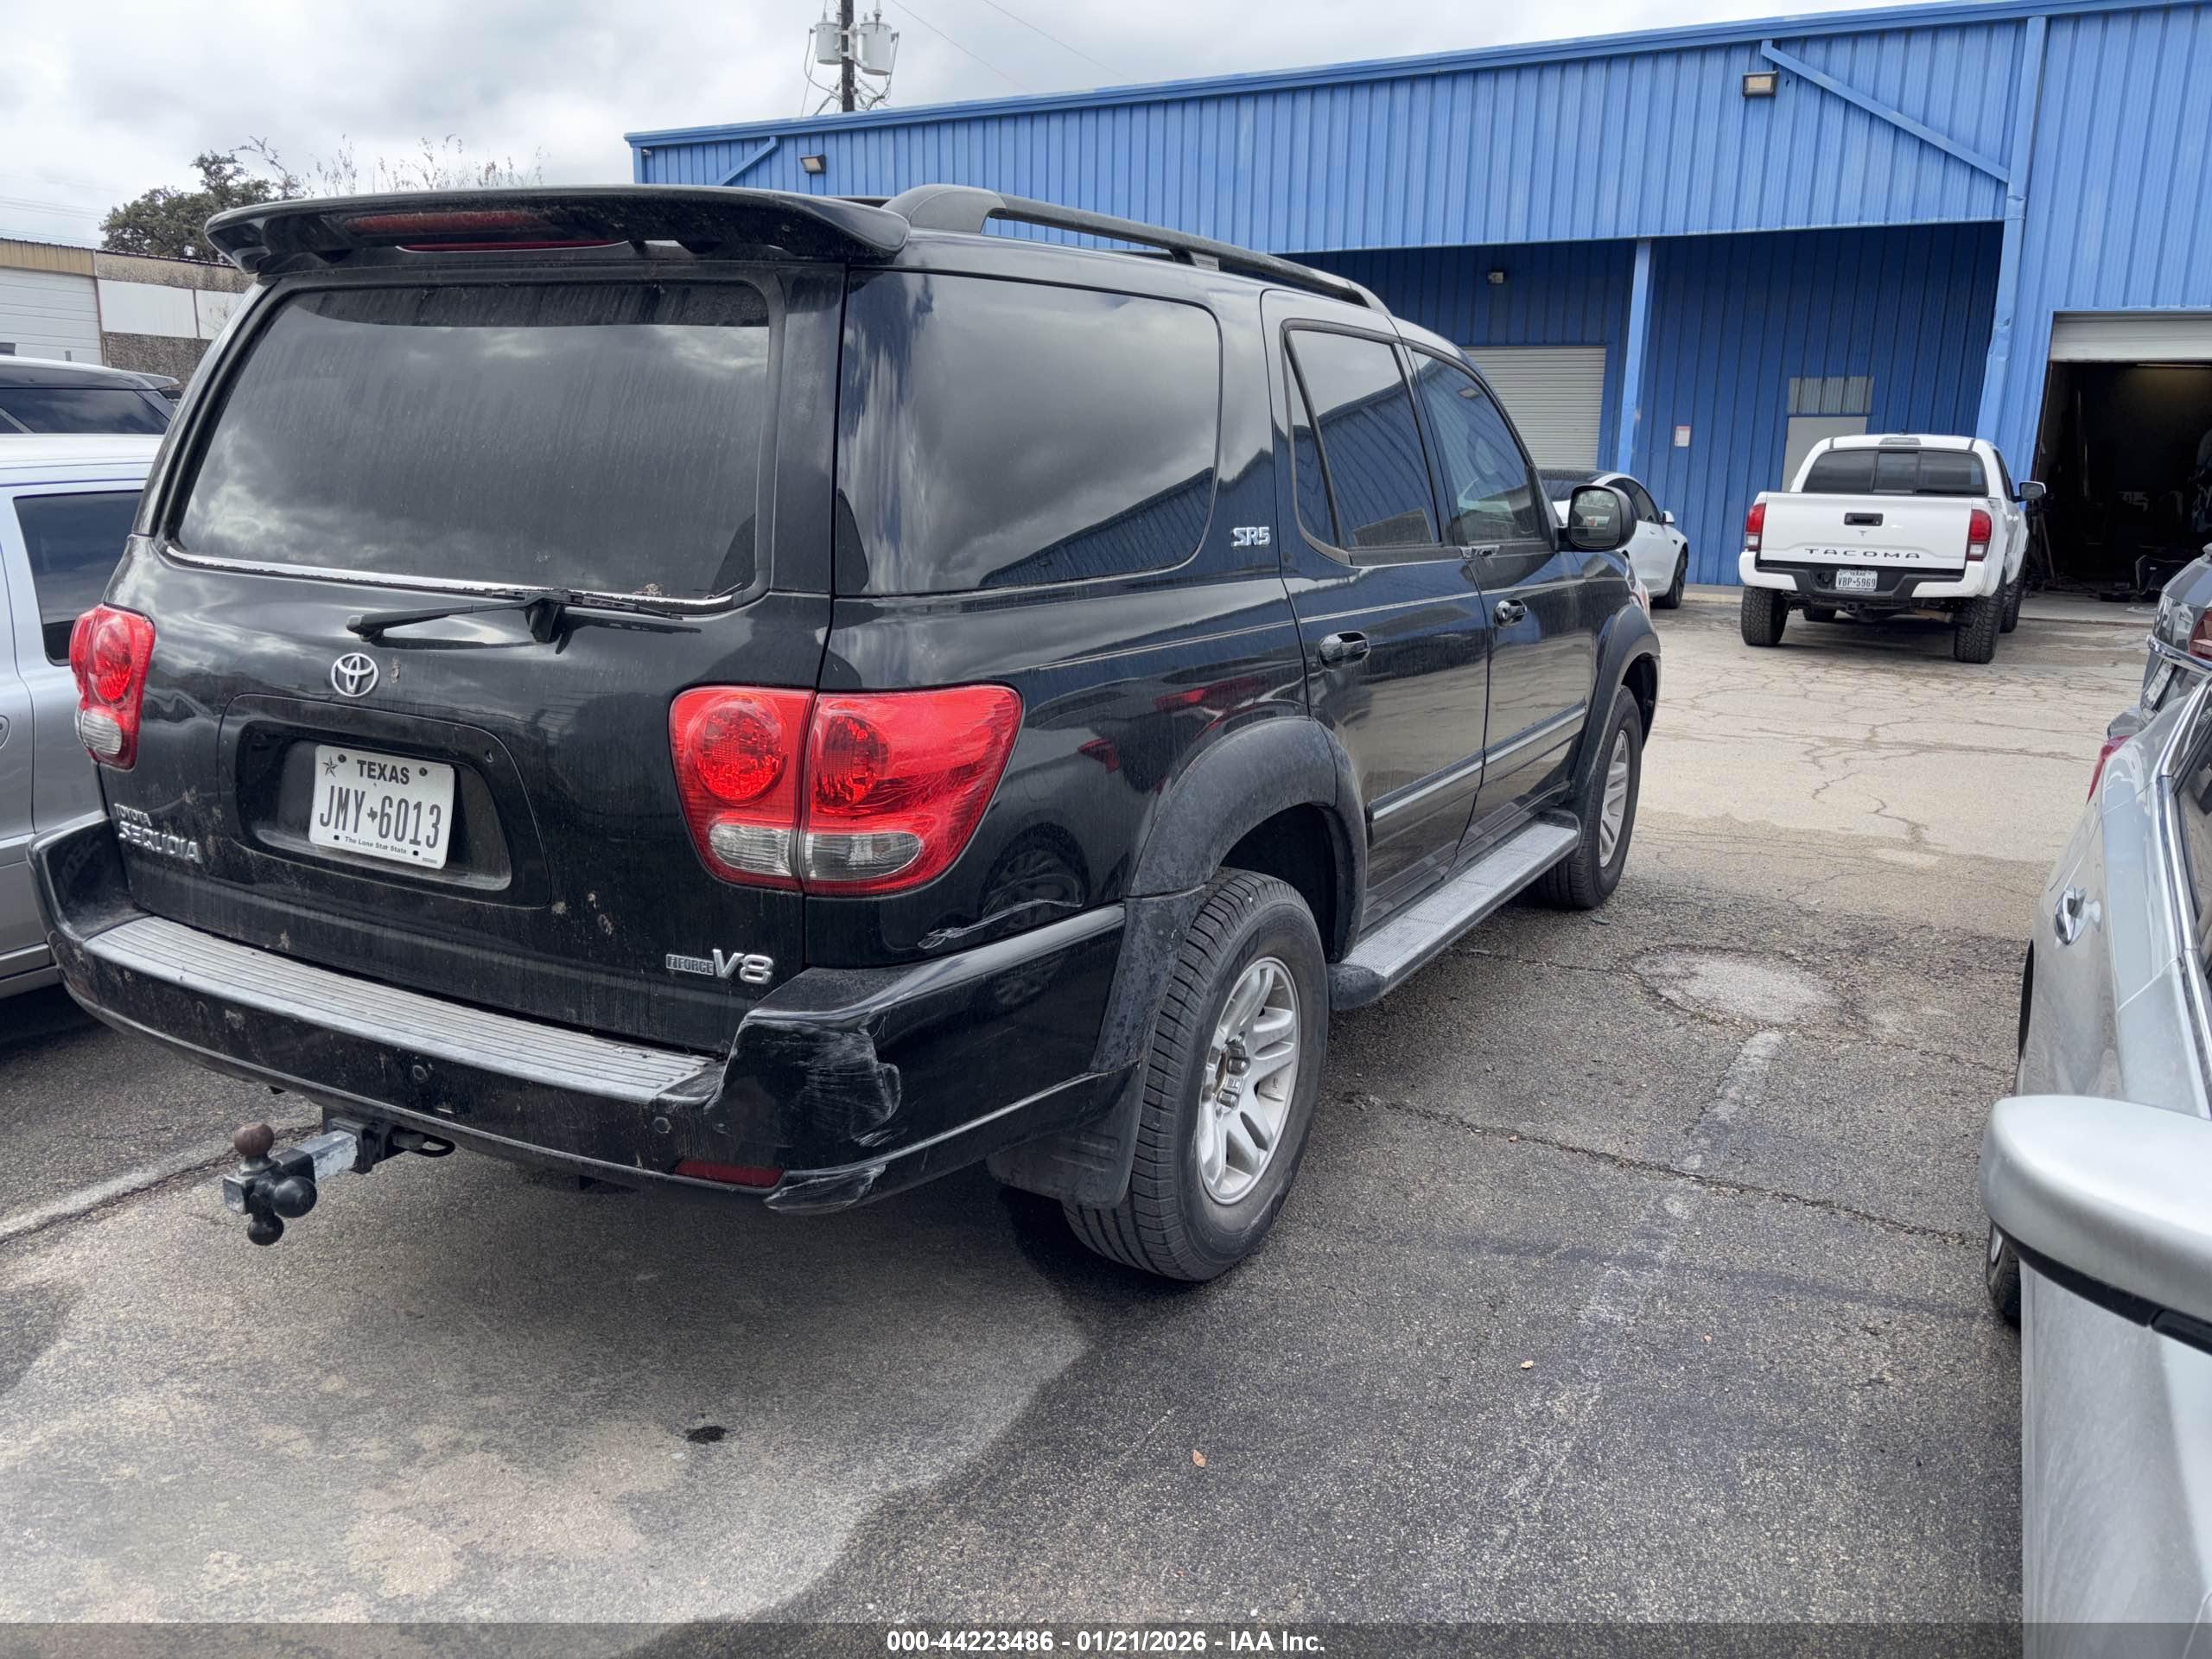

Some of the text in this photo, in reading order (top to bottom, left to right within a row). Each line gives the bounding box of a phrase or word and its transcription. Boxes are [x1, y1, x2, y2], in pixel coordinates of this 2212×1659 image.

[1230, 526, 1271, 546] SR5
[1804, 548, 1920, 559] TACOMA
[356, 759, 410, 785] TEXAS
[113, 803, 152, 827] TOYOTA
[118, 820, 203, 864] SEQUOIA
[345, 836, 407, 855] The Lone Star State
[711, 948, 774, 984] V8
